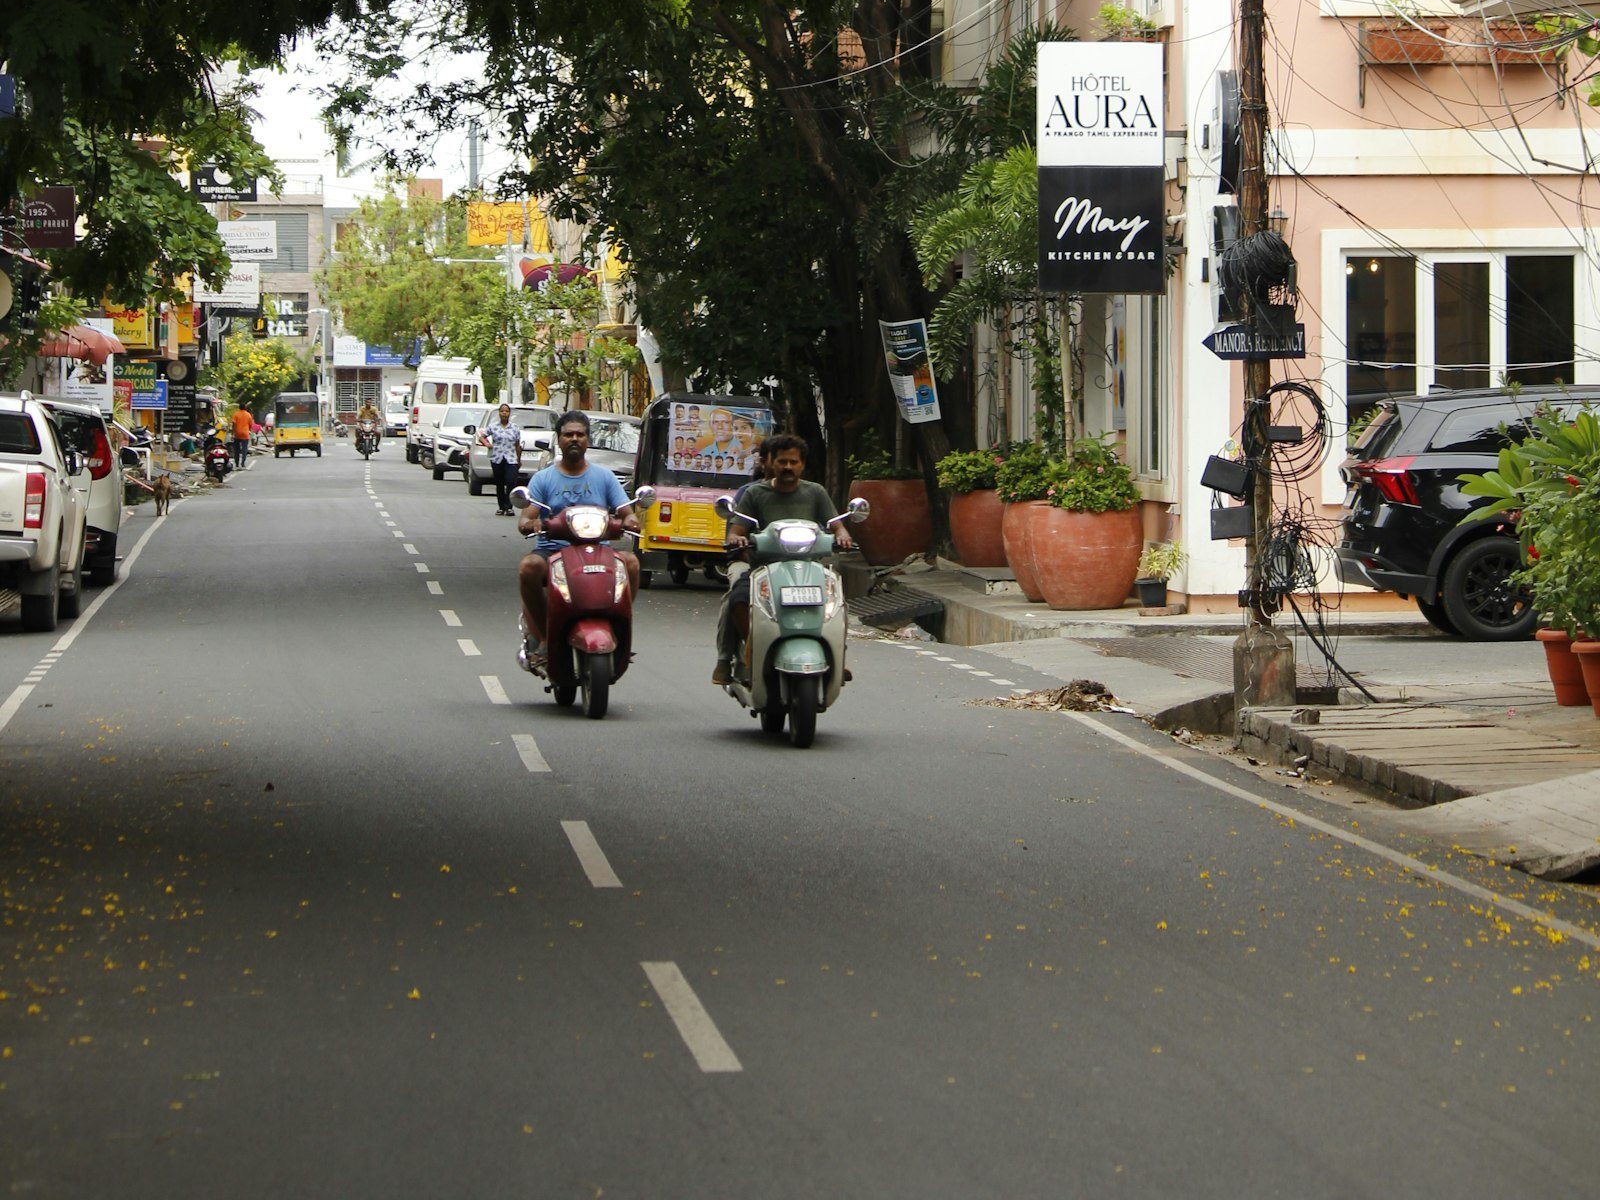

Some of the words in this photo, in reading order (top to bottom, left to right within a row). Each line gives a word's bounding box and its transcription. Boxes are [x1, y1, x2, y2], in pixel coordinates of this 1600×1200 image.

[1072, 73, 1131, 91] HÔTEL
[1045, 94, 1157, 128] AURA
[200, 186, 236, 194] SUPREME
[29, 208, 48, 216] 1952
[1054, 196, 1150, 252] May
[1048, 252, 1112, 260] KITCHEN
[1115, 252, 1123, 260] &
[1127, 252, 1155, 260] BAR
[124, 365, 154, 376] Netra
